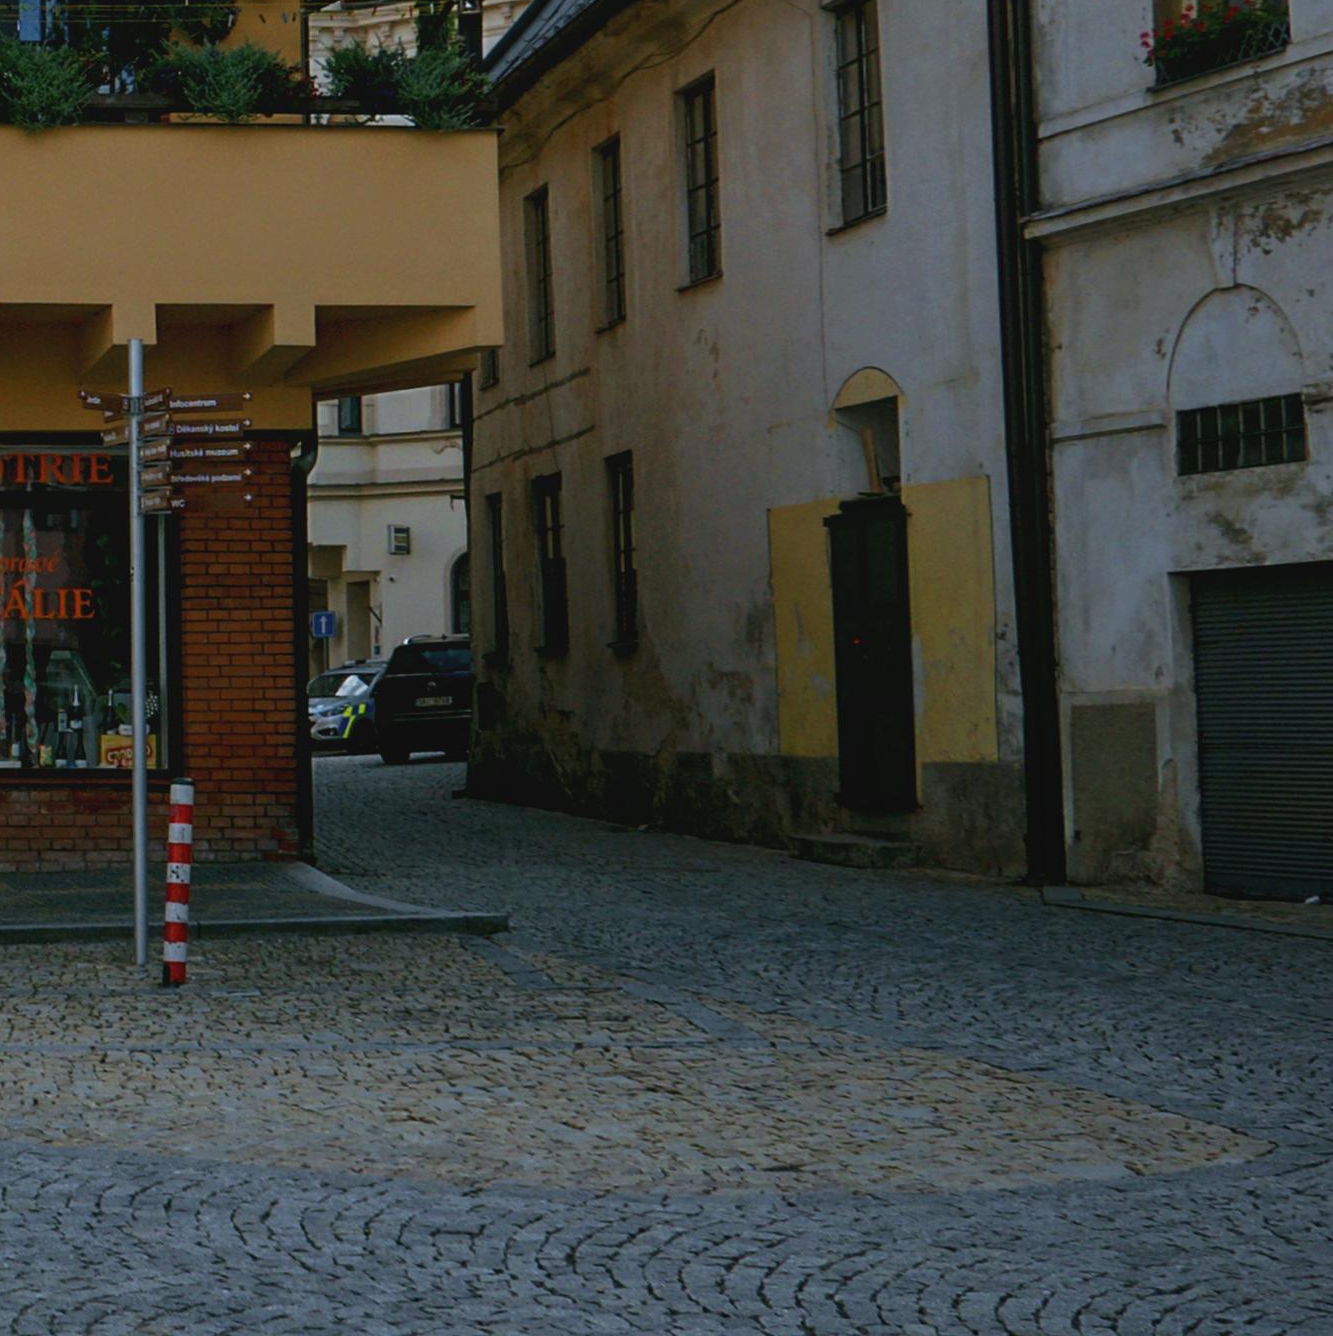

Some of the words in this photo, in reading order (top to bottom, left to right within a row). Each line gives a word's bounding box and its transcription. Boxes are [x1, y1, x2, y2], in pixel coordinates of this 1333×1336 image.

[169, 399, 217, 409] Infocentrum
[176, 424, 214, 435] Děkanský
[215, 423, 240, 433] kostel
[169, 449, 203, 458] Husitské
[204, 449, 239, 457] muzeum
[170, 498, 186, 508] WC
